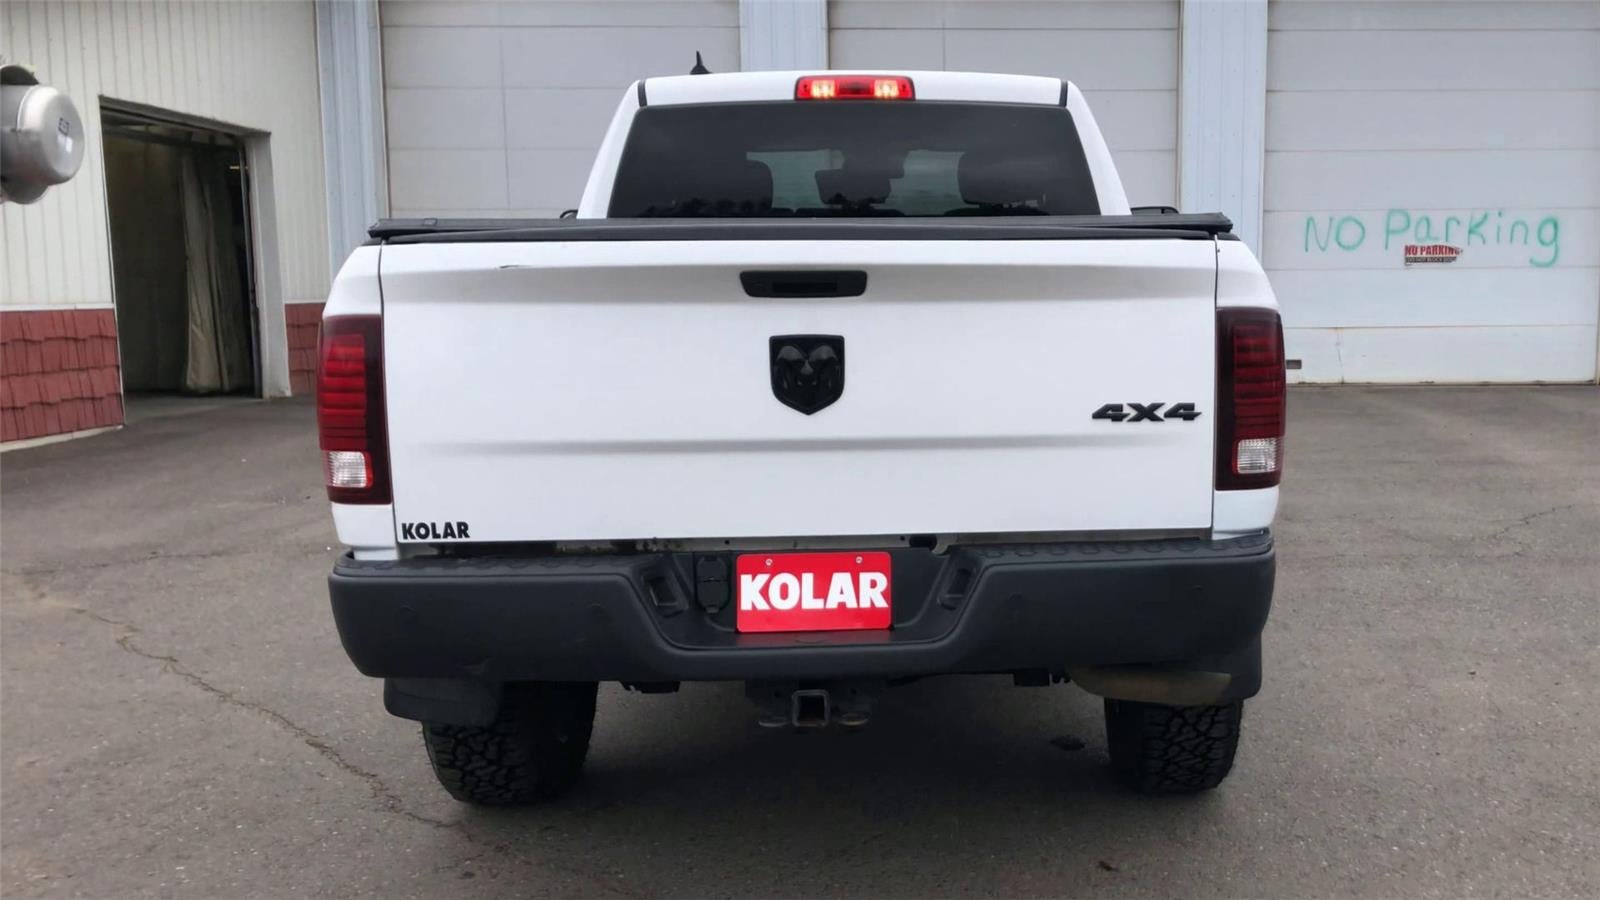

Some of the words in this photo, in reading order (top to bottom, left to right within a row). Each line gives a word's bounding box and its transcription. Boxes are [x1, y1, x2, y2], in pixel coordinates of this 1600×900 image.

[1304, 215, 1365, 253] NO
[1405, 245, 1418, 256] NO
[1091, 402, 1202, 422] 4X4
[401, 521, 470, 540] KOLAR
[740, 572, 889, 611] KOLAR
